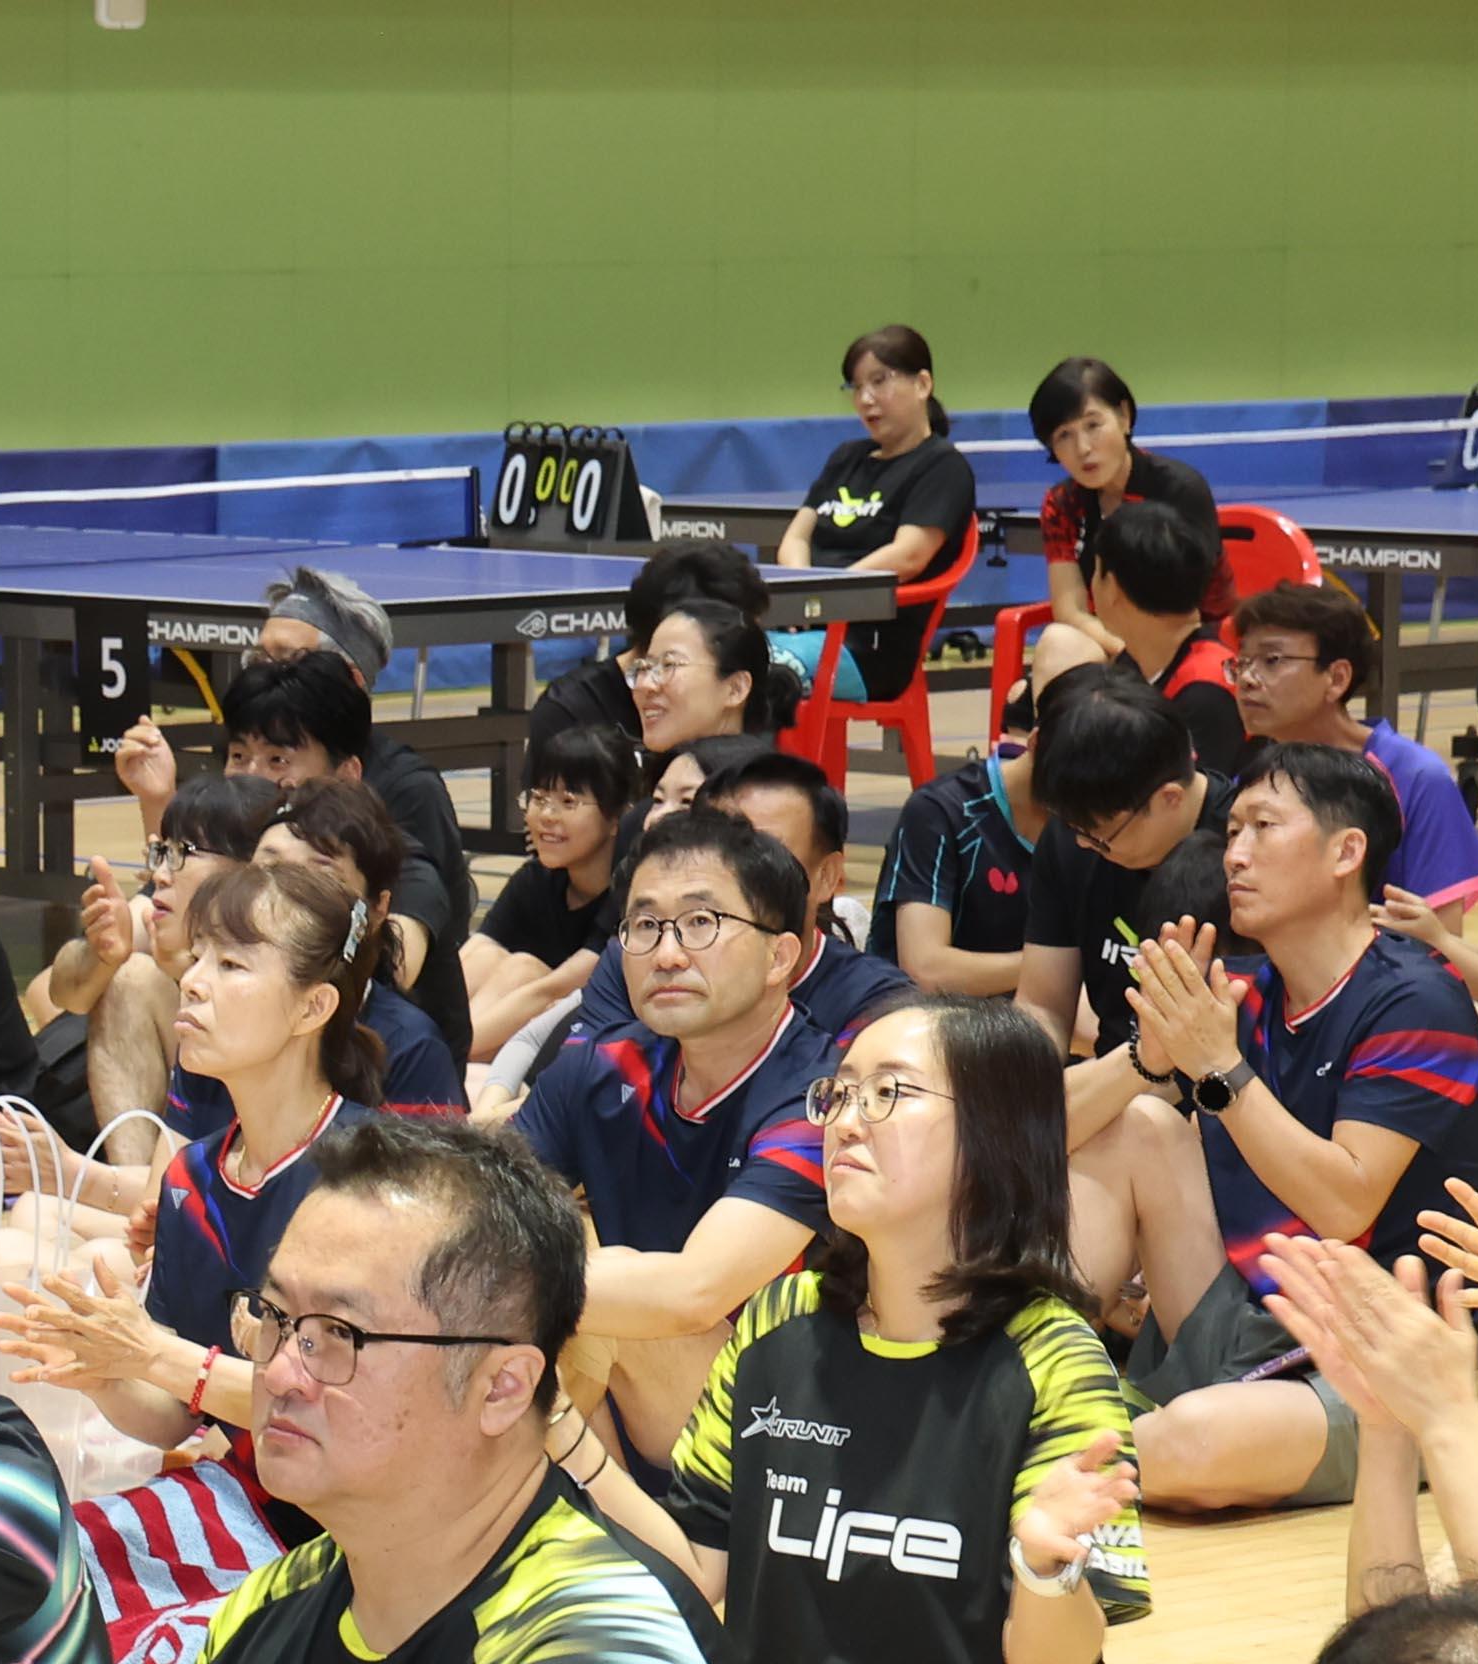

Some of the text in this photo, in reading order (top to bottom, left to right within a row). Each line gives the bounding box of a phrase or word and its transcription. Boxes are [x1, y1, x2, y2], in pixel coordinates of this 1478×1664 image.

[498, 453, 527, 526] 0
[536, 456, 556, 502] 0
[571, 458, 603, 532] 0
[659, 521, 726, 540] MPION
[1315, 545, 1442, 570] CHAMPION
[549, 611, 628, 636] CHAM
[101, 637, 128, 699] 5
[765, 1468, 809, 1495] Team
